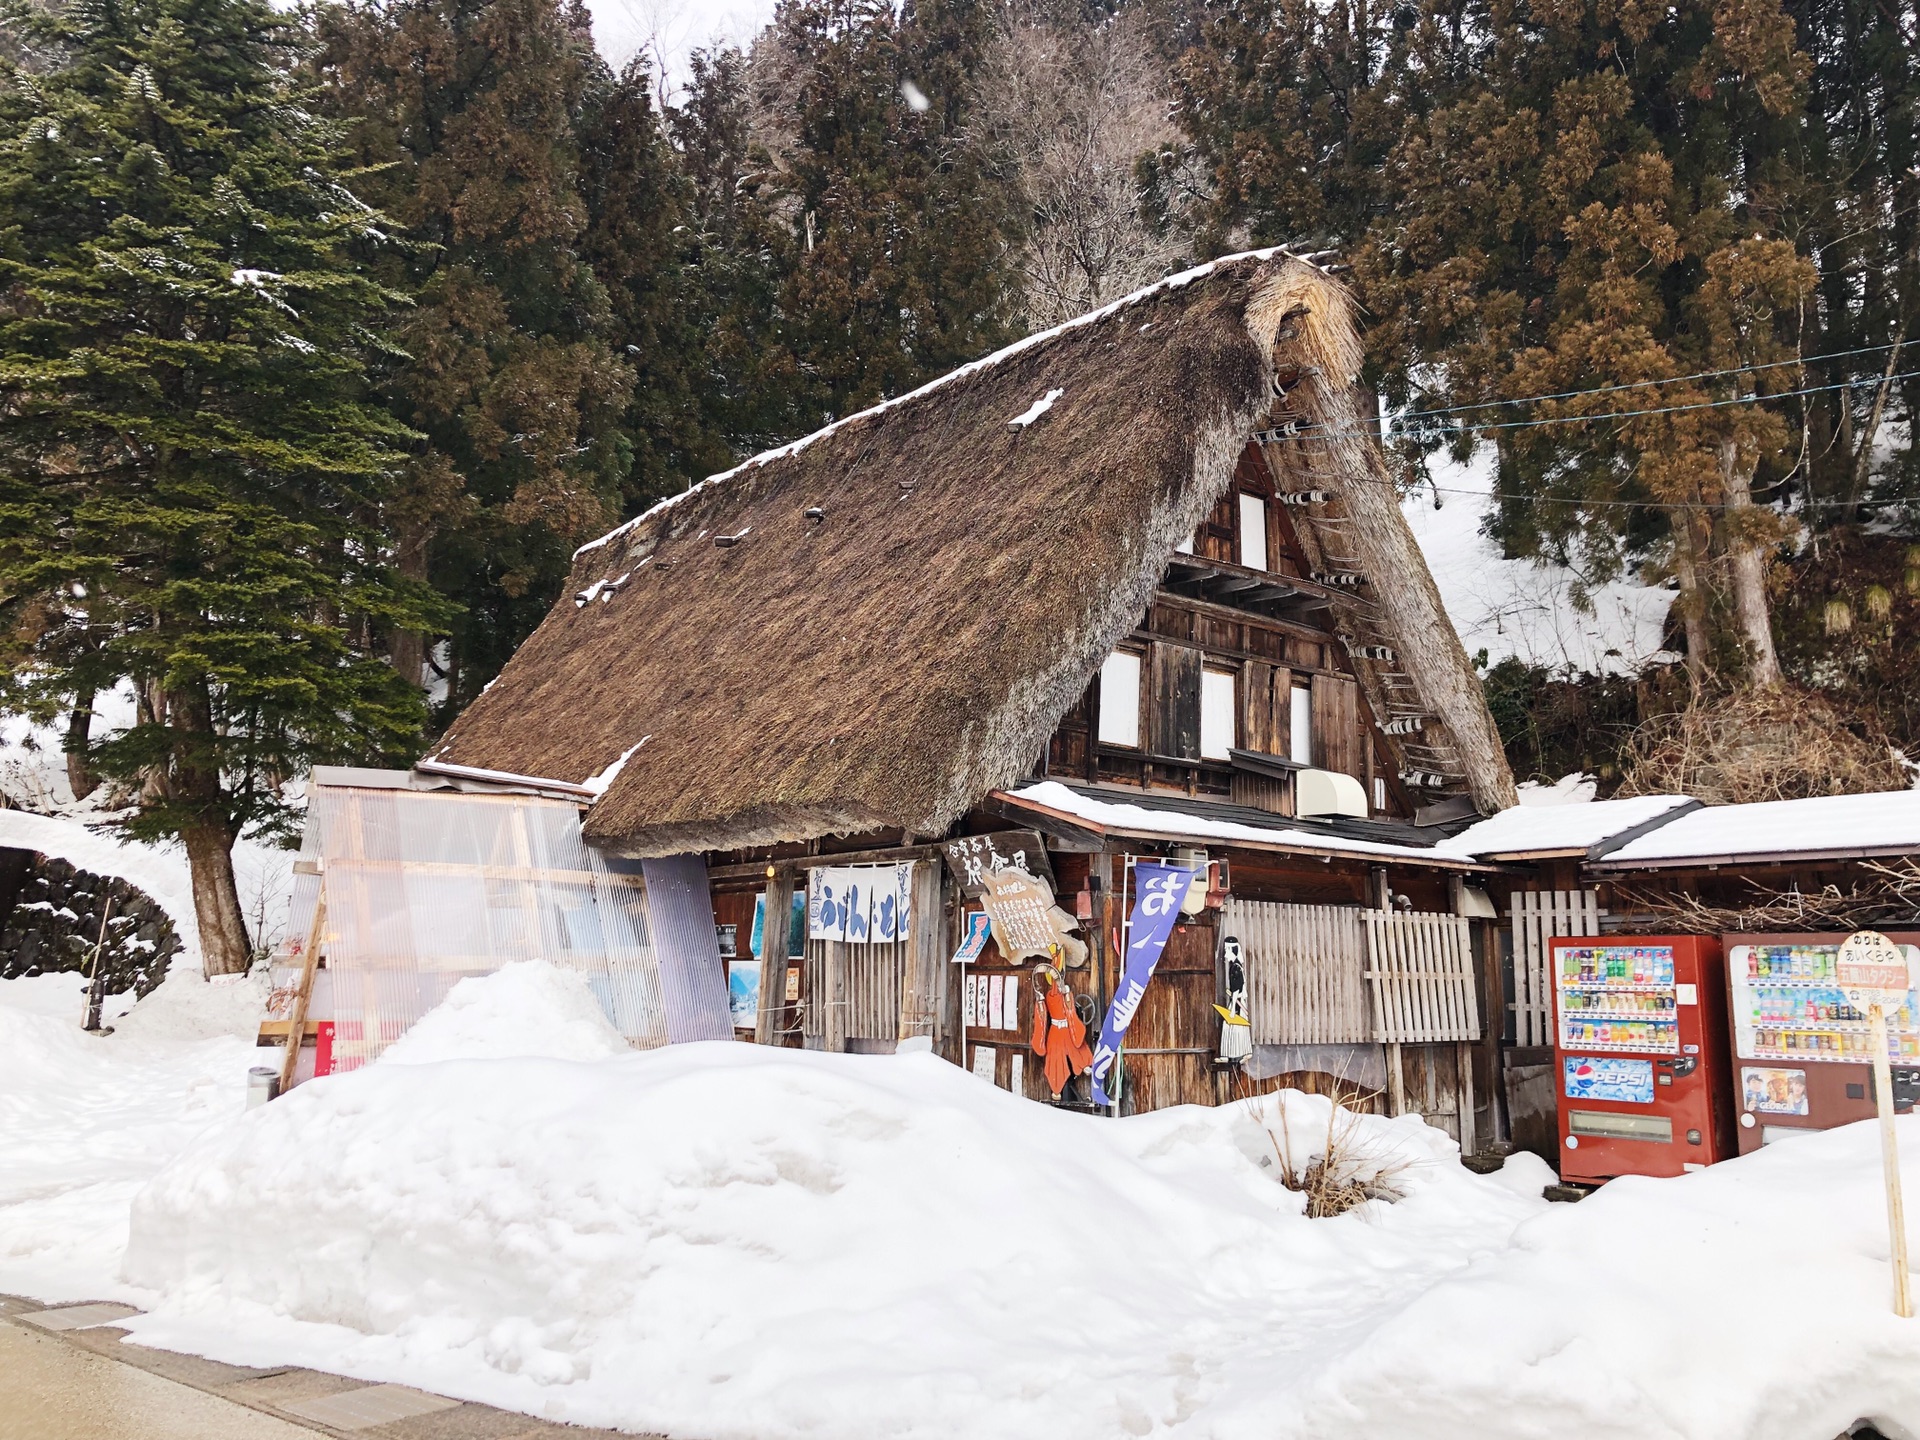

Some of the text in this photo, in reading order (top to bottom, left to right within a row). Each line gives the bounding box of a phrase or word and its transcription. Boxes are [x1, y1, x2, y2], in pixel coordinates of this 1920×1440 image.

[1853, 935, 1881, 946] のりば
[1593, 1071, 1647, 1087] PEPSI
